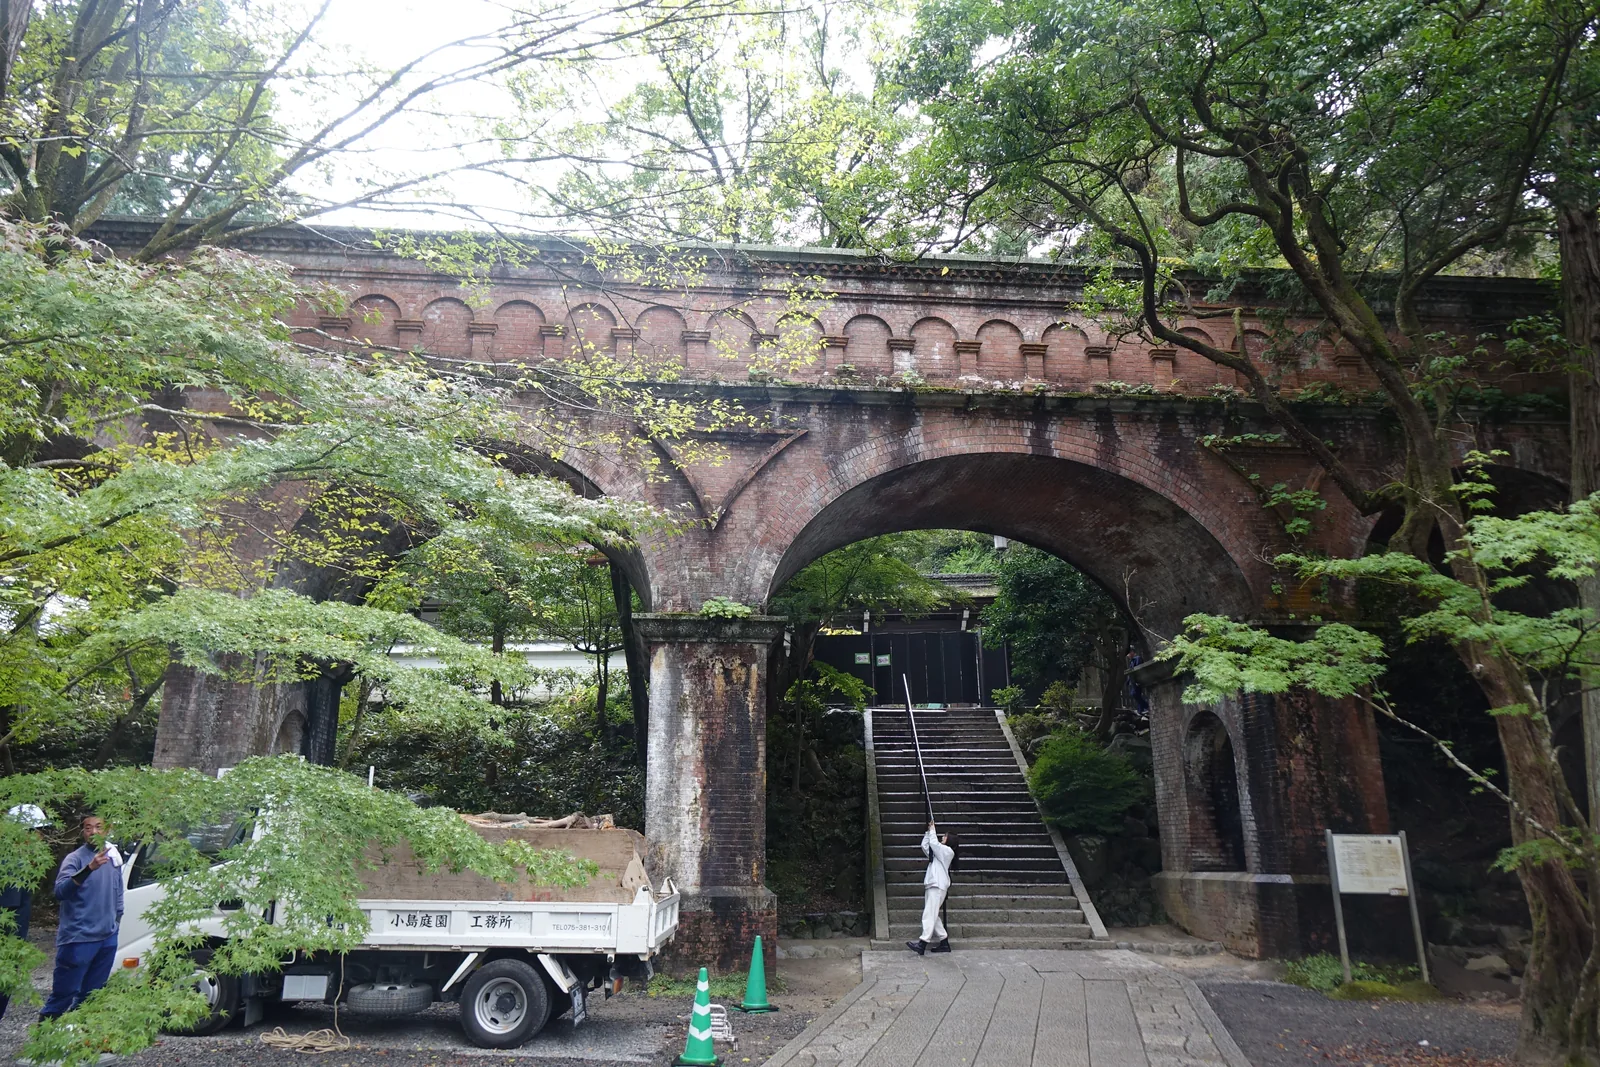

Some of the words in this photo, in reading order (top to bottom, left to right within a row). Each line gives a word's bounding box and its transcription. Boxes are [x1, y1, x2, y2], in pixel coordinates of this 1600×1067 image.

[390, 913, 448, 928] 小島庭園
[470, 915, 513, 929] 工務所
